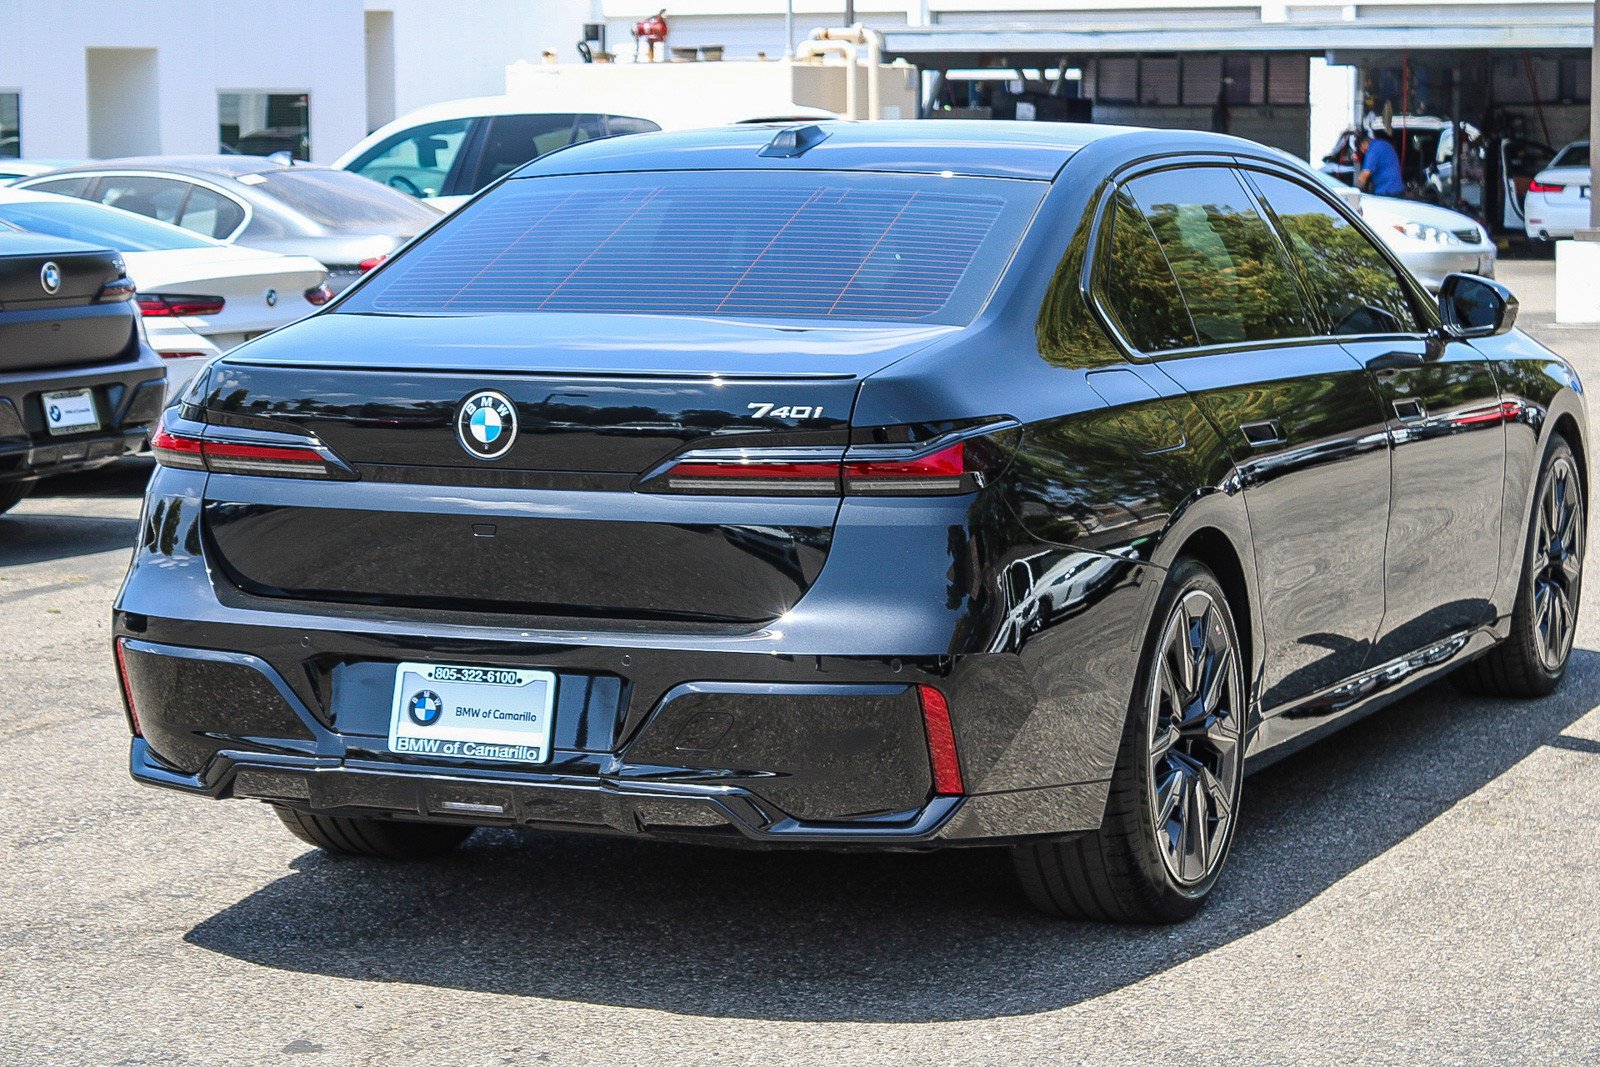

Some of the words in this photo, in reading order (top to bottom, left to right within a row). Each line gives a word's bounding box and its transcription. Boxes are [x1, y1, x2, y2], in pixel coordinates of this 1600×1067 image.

[465, 396, 510, 417] BMW
[435, 667, 516, 684] 805-322-6100
[411, 690, 441, 706] BMW
[455, 706, 481, 718] BMW
[482, 709, 492, 719] of
[492, 709, 537, 722] Camarillo
[397, 737, 441, 752] BMW
[443, 742, 460, 755] of
[463, 743, 538, 761] Camarillo
